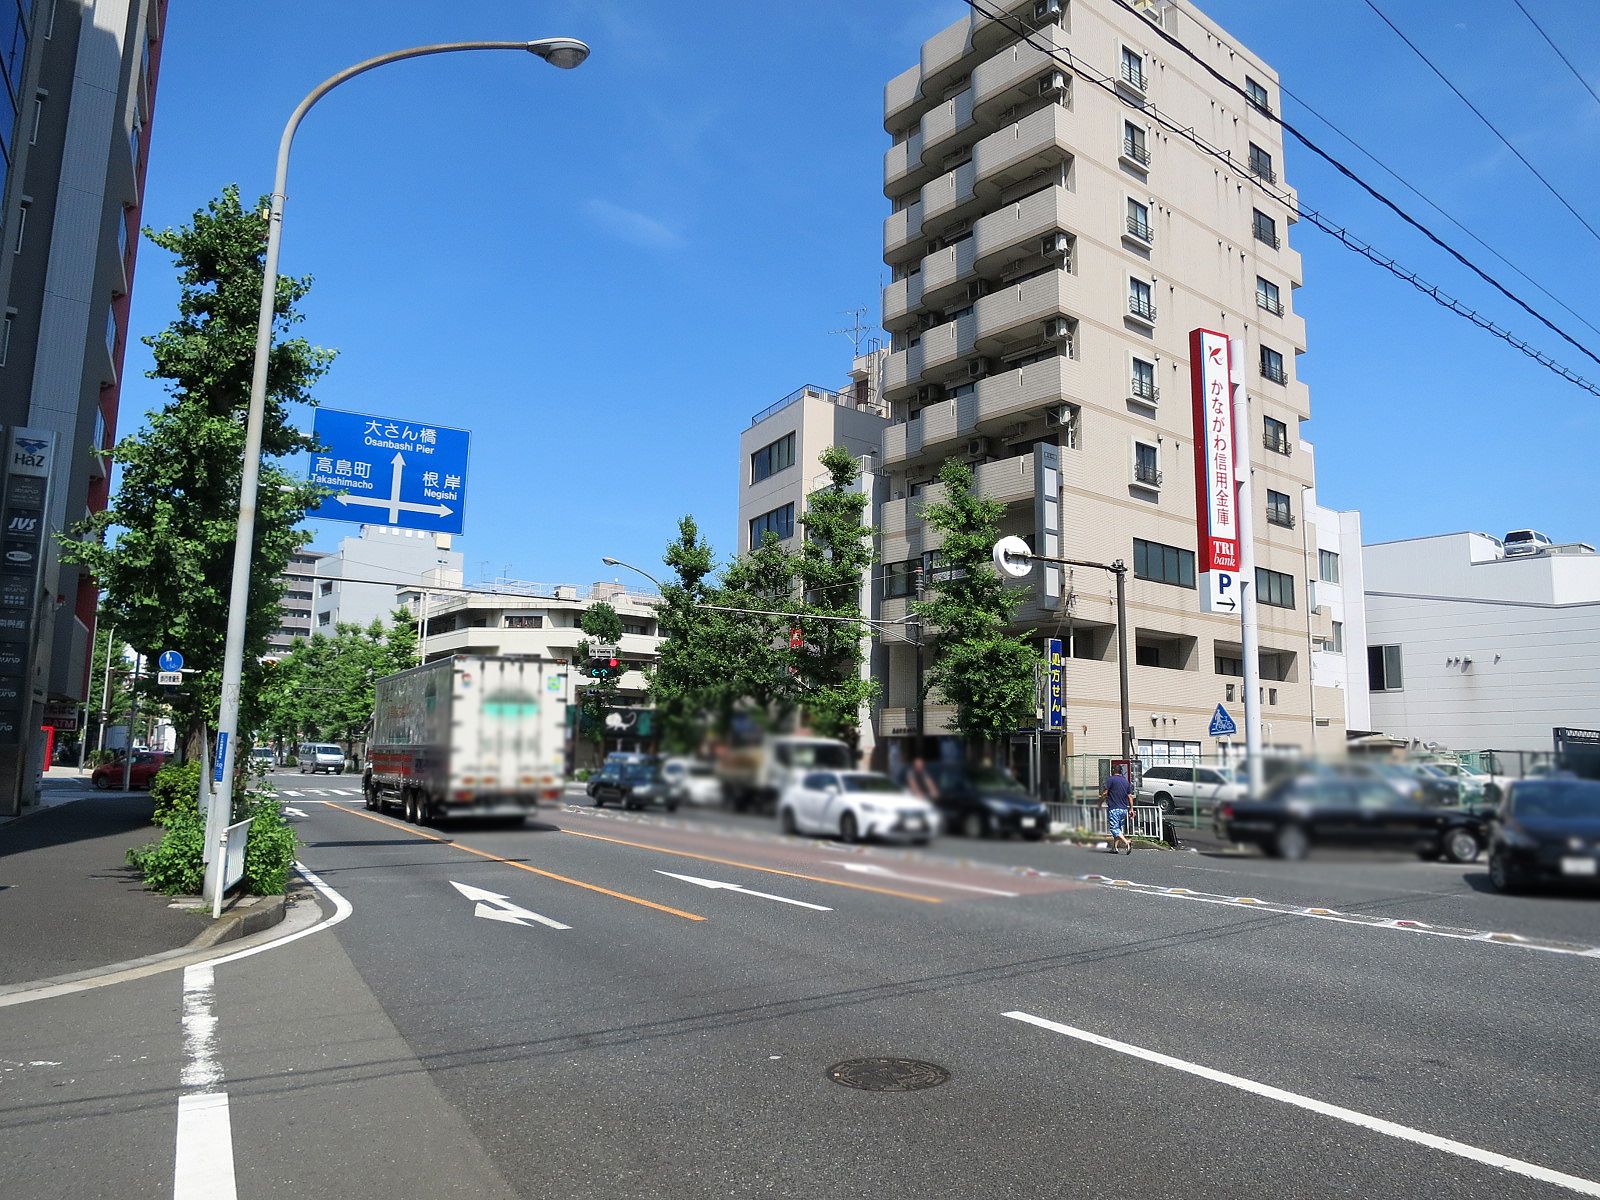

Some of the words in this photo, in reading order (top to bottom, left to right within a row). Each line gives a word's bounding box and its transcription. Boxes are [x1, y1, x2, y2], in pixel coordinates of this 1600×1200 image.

[364, 420, 437, 445] 大さん橋
[364, 436, 413, 451] Osanbashi
[416, 444, 435, 454] Pier
[1211, 379, 1230, 526] かながわ信用金庫
[315, 456, 372, 479] 高島町
[311, 473, 374, 490] Takashimacho
[422, 470, 461, 490] 根岸
[424, 488, 457, 500] Negishi
[8, 517, 37, 531] JVS
[1213, 540, 1234, 556] TRI
[1213, 553, 1236, 567] bank
[1219, 573, 1232, 594] P
[1051, 652, 1061, 713] 処方せん
